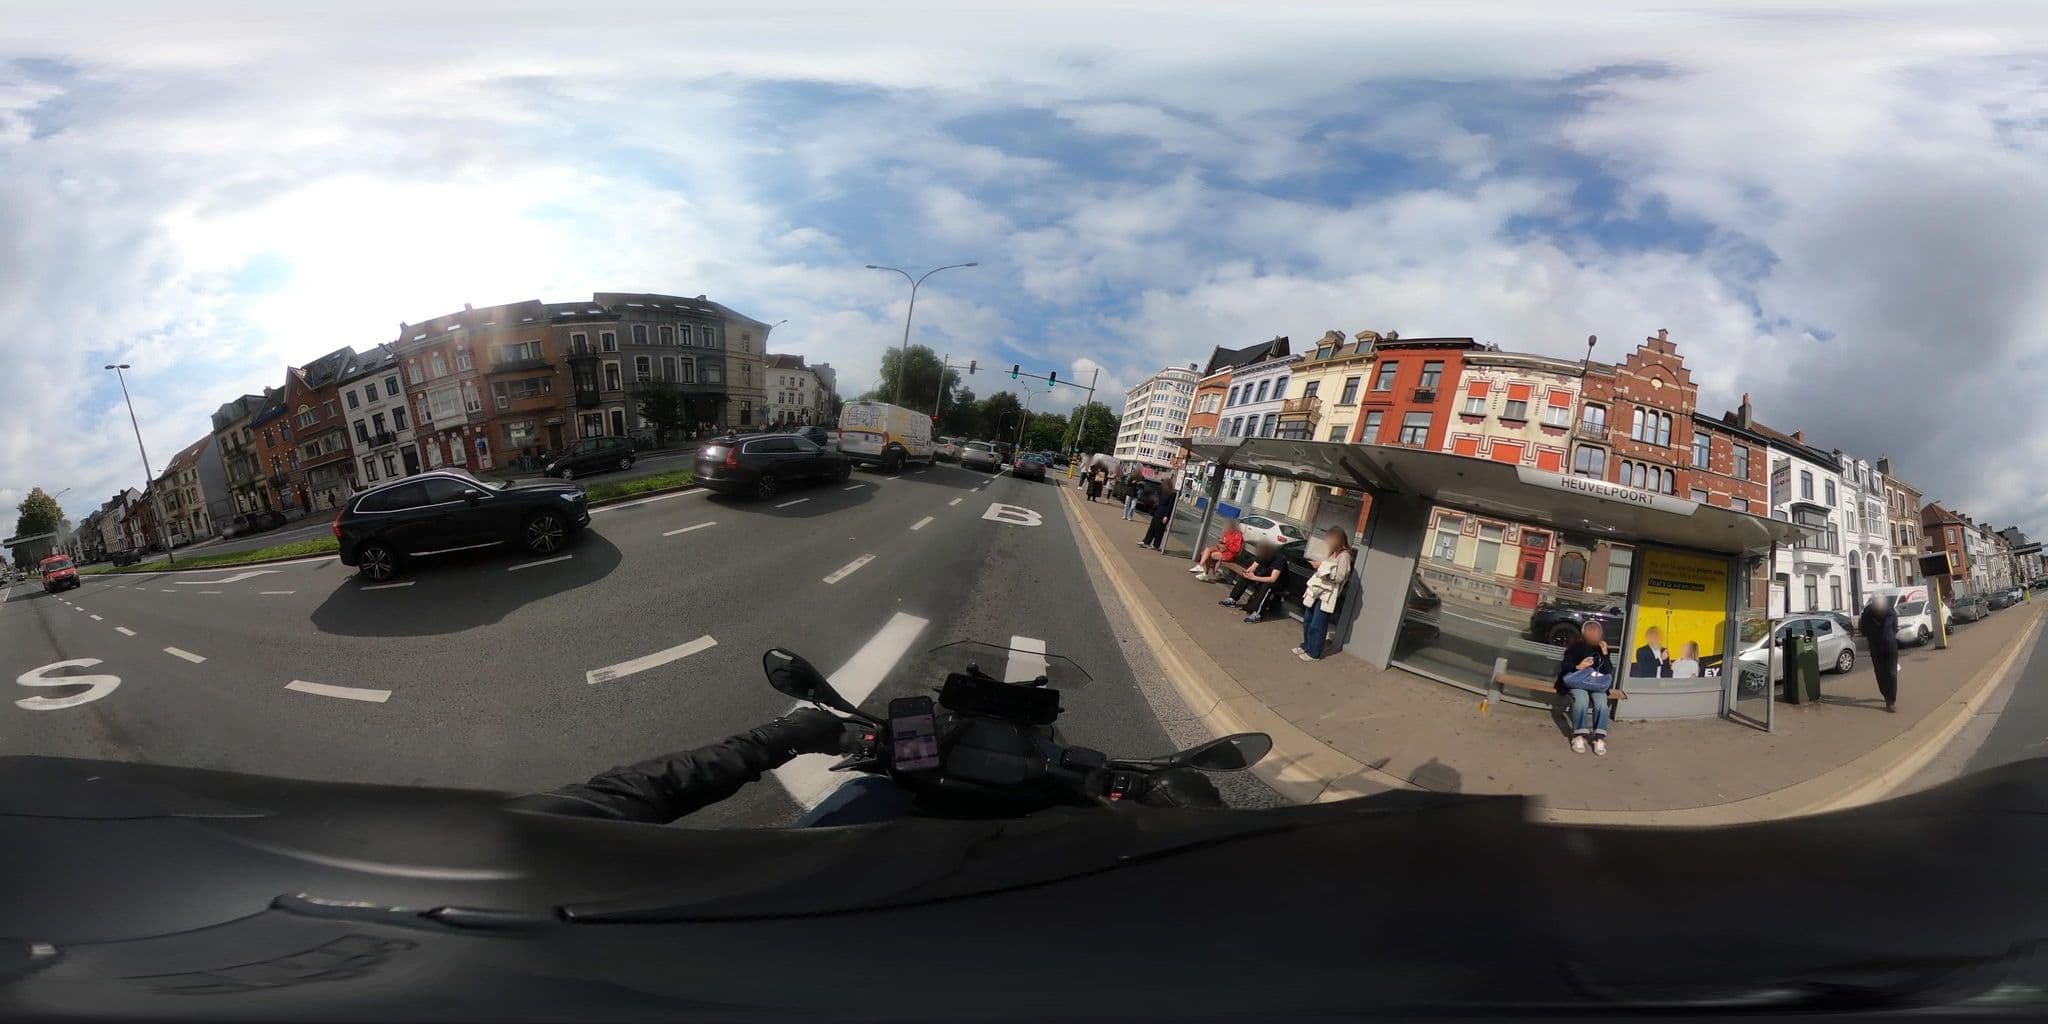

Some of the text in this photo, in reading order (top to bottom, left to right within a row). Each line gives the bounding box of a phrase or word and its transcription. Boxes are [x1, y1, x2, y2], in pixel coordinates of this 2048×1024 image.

[1561, 477, 1655, 504] HEUVELPOORT
[982, 503, 1042, 526] B
[16, 658, 122, 711] S
[1704, 668, 1720, 677] EY
